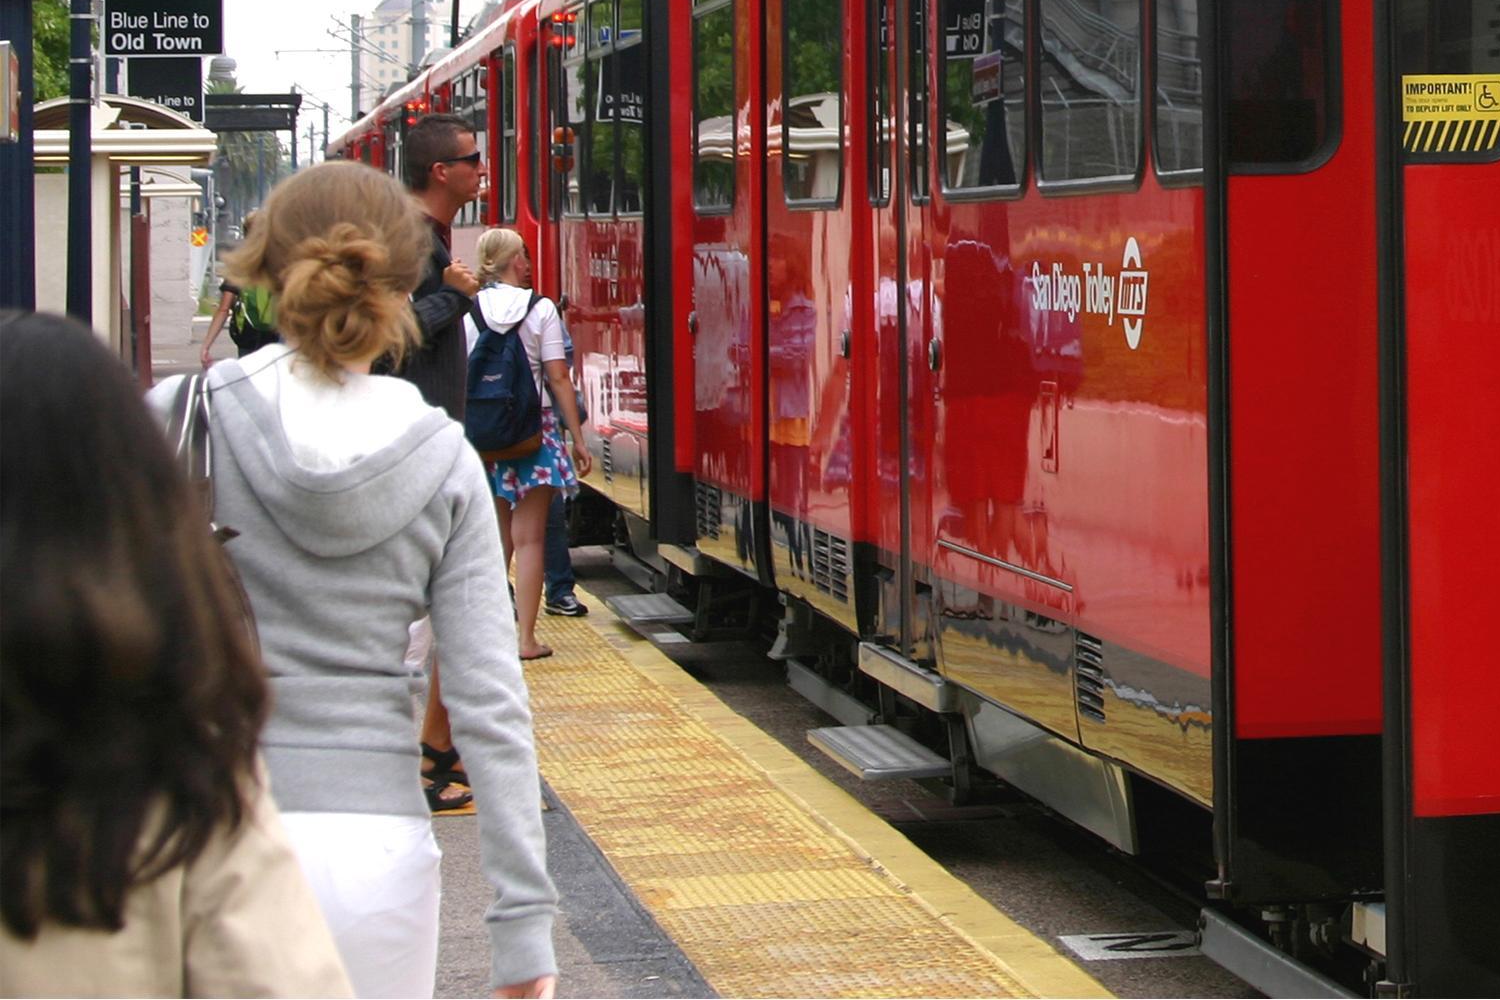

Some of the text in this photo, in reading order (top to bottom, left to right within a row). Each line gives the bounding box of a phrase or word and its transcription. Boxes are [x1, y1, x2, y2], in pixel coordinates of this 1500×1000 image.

[110, 11, 210, 30] Blue Line to
[111, 32, 202, 51] Old Town
[1406, 82, 1472, 95] IMPORTANT!
[183, 95, 195, 107] to
[1032, 261, 1115, 326] San Diego Trolley
